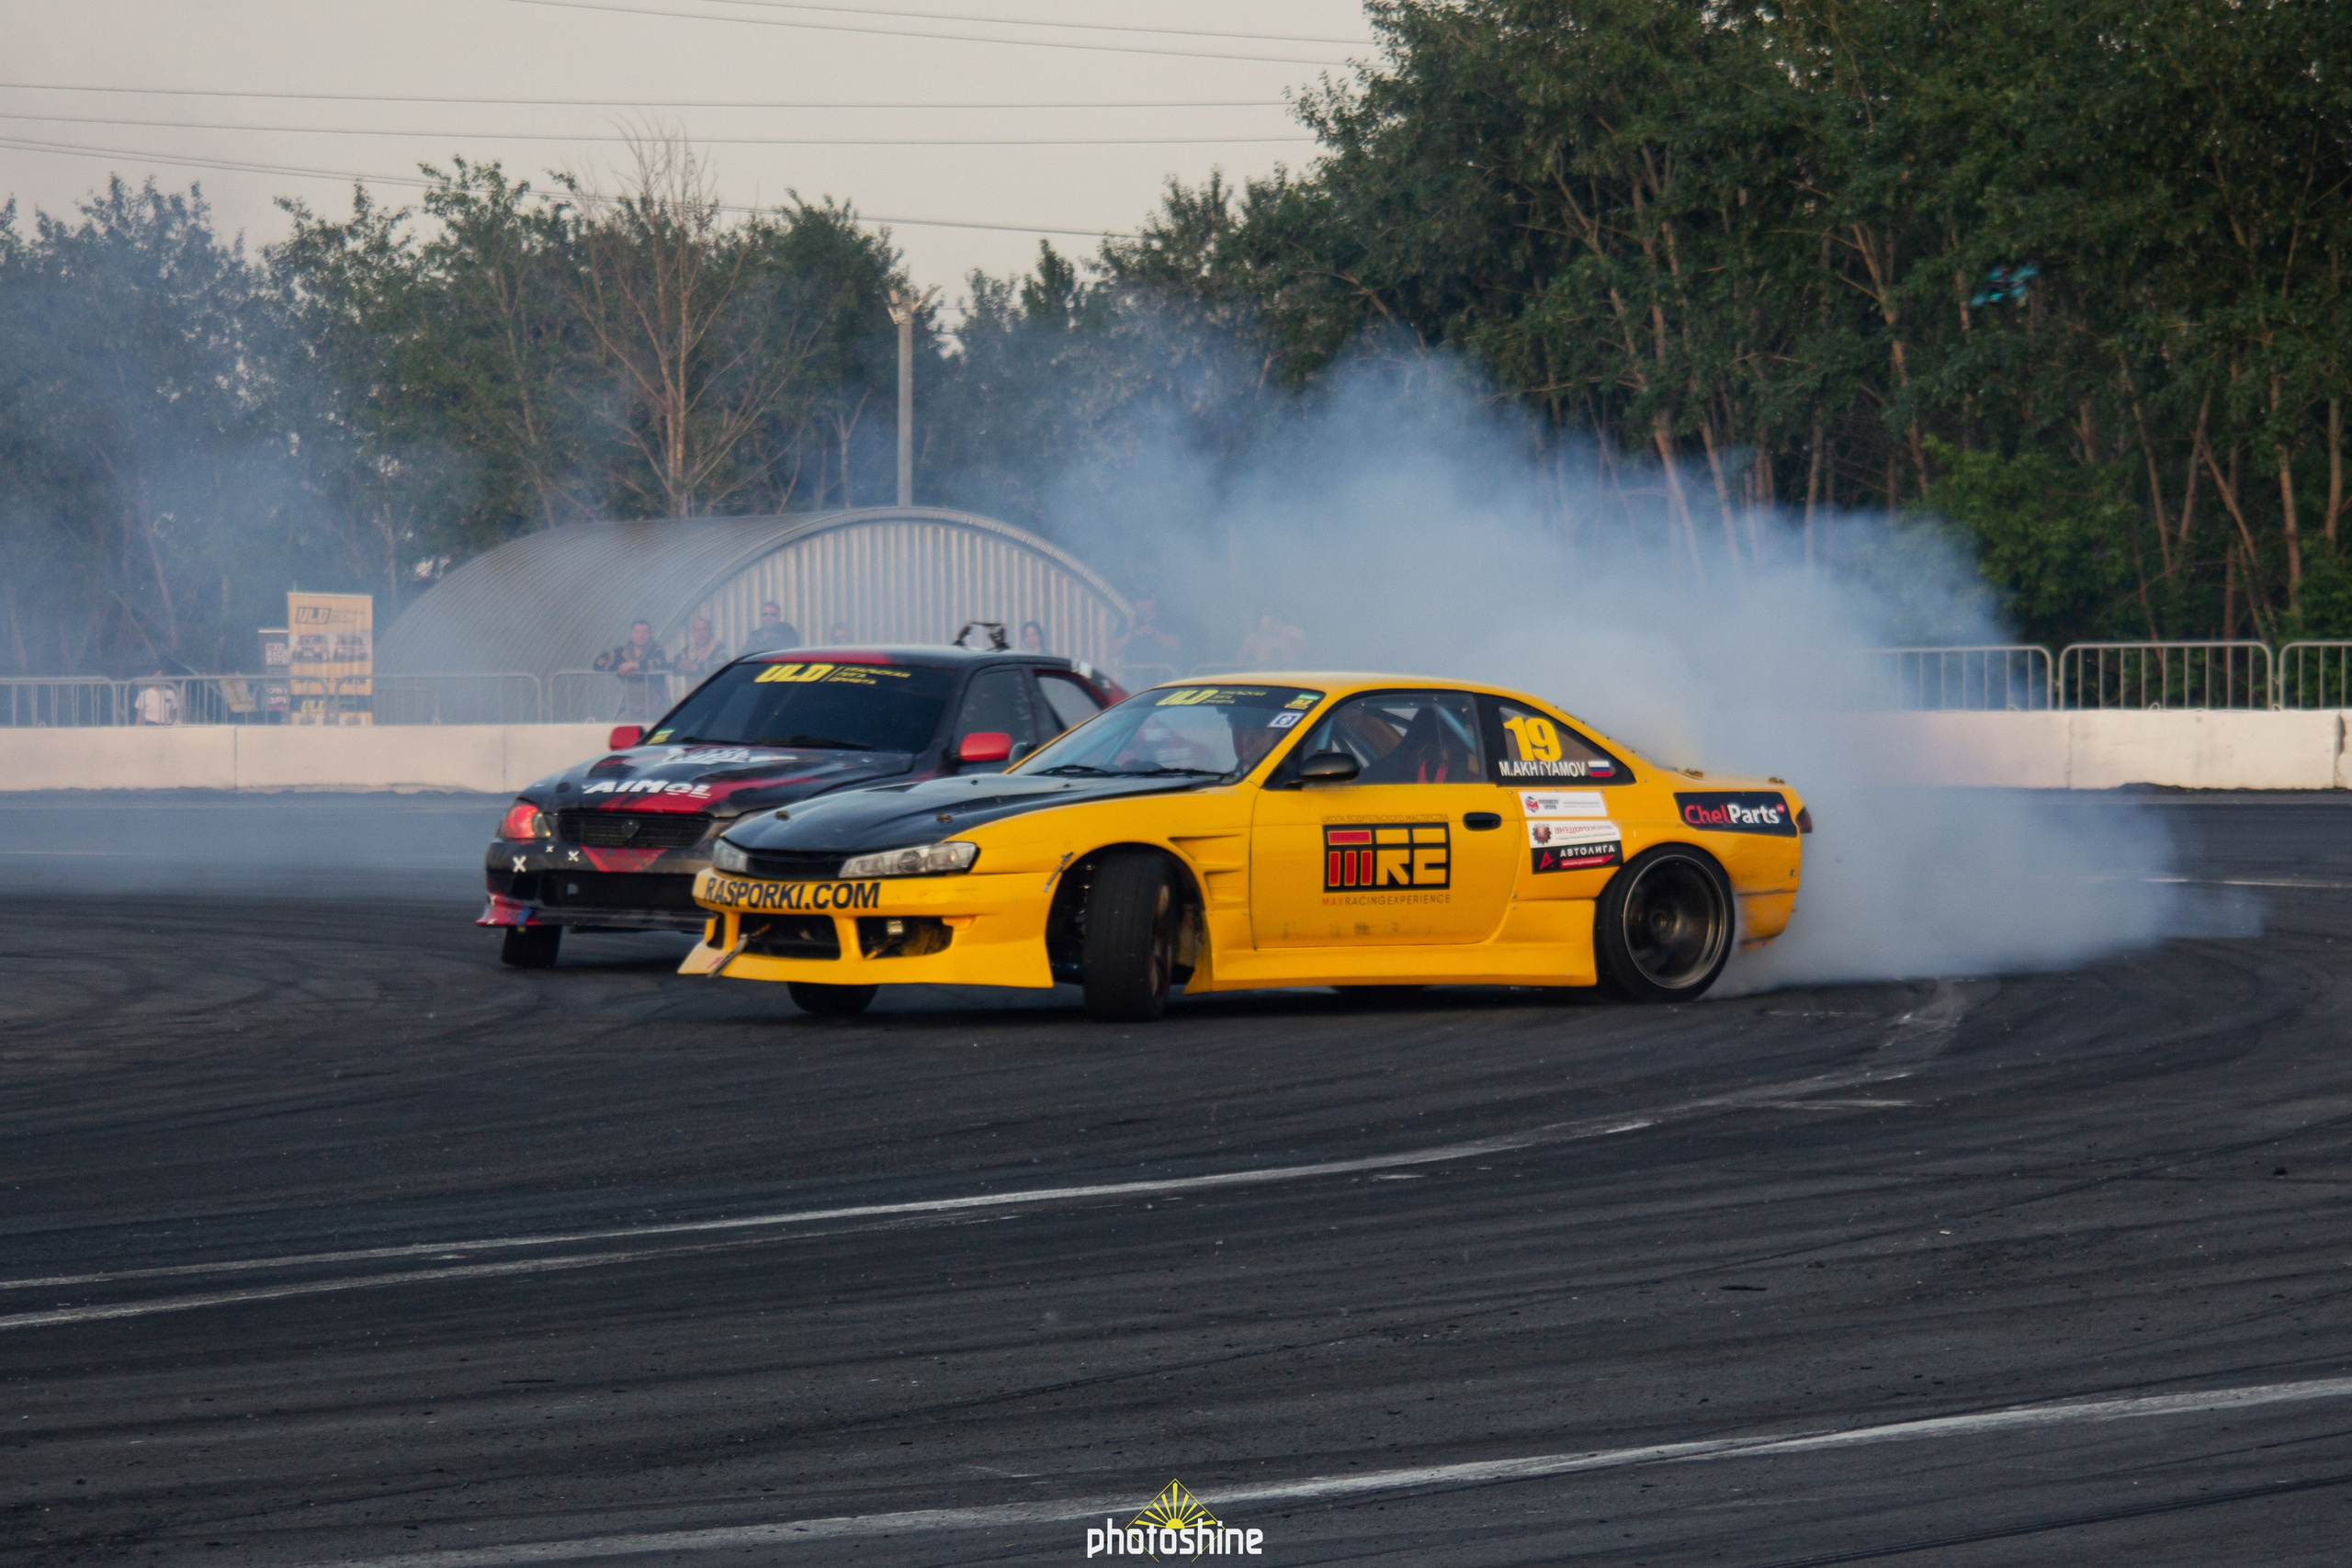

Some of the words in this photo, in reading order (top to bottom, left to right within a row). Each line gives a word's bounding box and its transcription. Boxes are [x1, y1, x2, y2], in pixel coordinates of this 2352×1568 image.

[753, 664, 834, 682] ULD
[1155, 690, 1219, 706] ULD
[1503, 716, 1562, 761] 19
[1320, 815, 1346, 823] ШКОЛА
[1684, 803, 1780, 824] ChelParts
[1559, 845, 1615, 858] АВТОЛИГА
[703, 877, 881, 909] RASPORKI.COM
